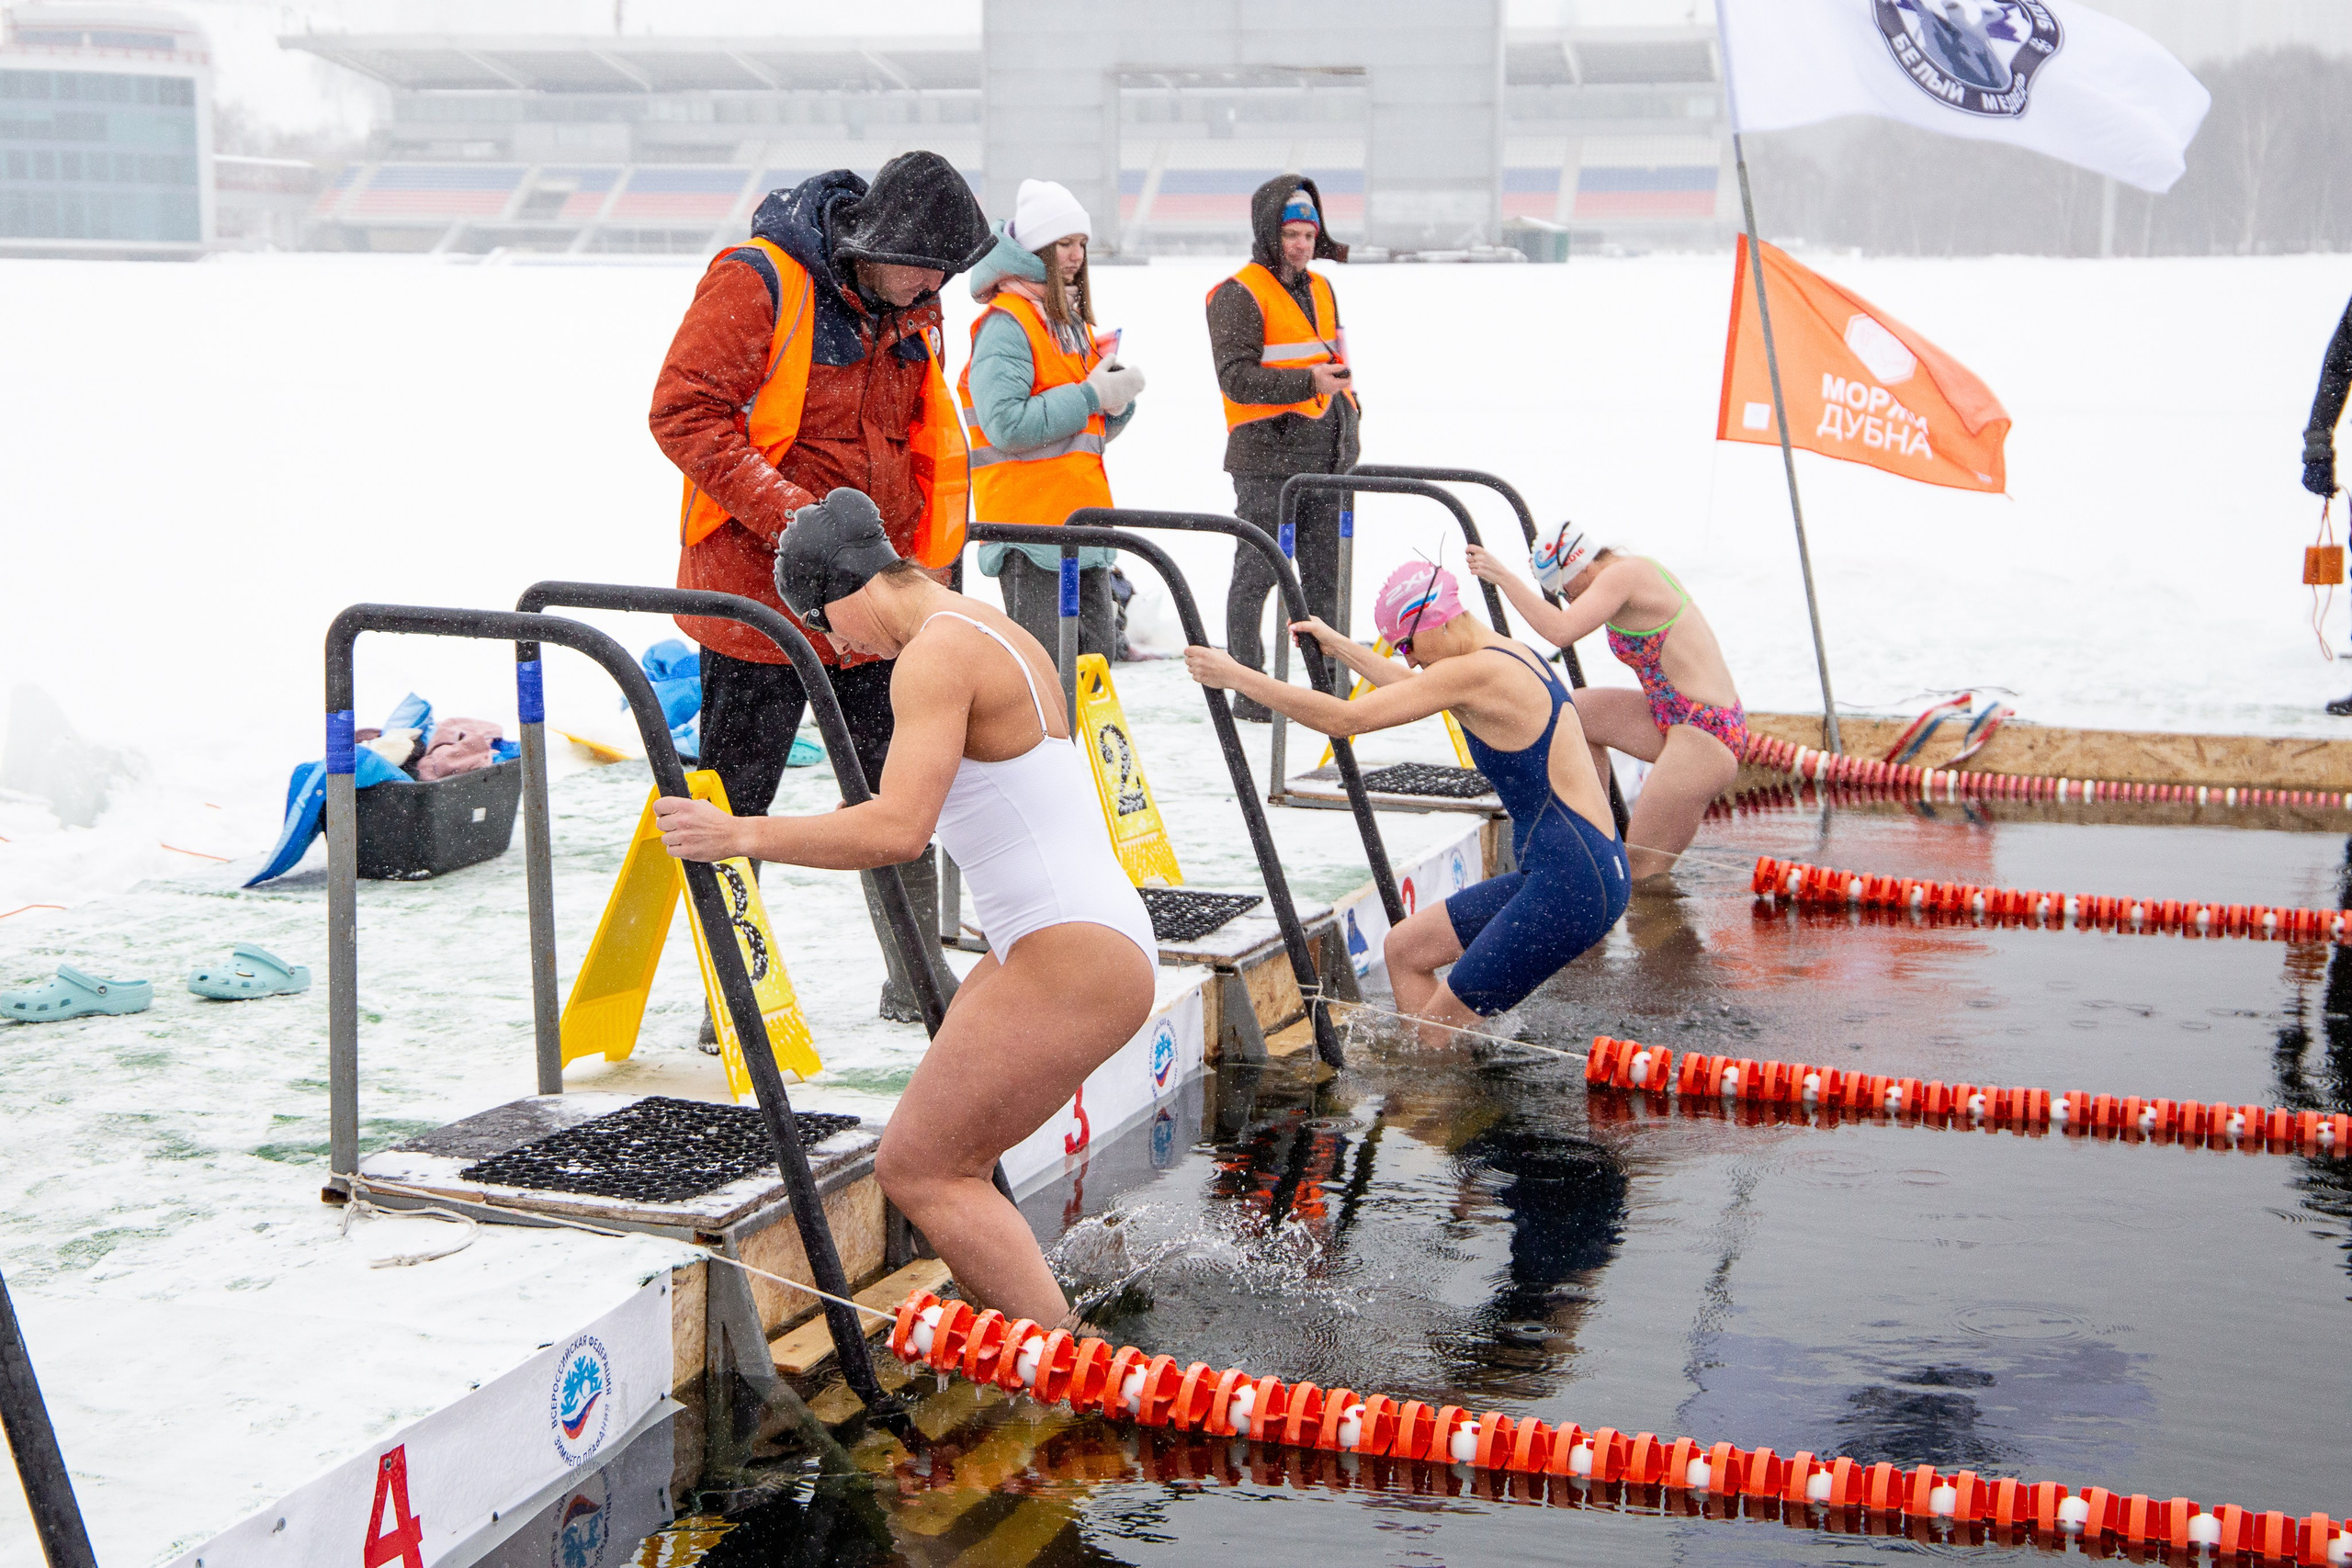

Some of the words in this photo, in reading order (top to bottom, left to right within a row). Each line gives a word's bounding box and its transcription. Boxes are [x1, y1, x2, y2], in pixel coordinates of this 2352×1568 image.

[1891, 32, 1965, 104] БЕЛЫЙ
[1816, 402, 1933, 459] ДУБНА
[1100, 724, 1148, 817] 2
[551, 1335, 587, 1429] ВСЕРОССИЙСКАЯ
[588, 1336, 612, 1395] ФЕДЕРАЦИЯ
[554, 1435, 582, 1467] ЗИМНЕГО
[582, 1404, 610, 1463] ПЛАВАНИЯ
[364, 1443, 424, 1568] 4
